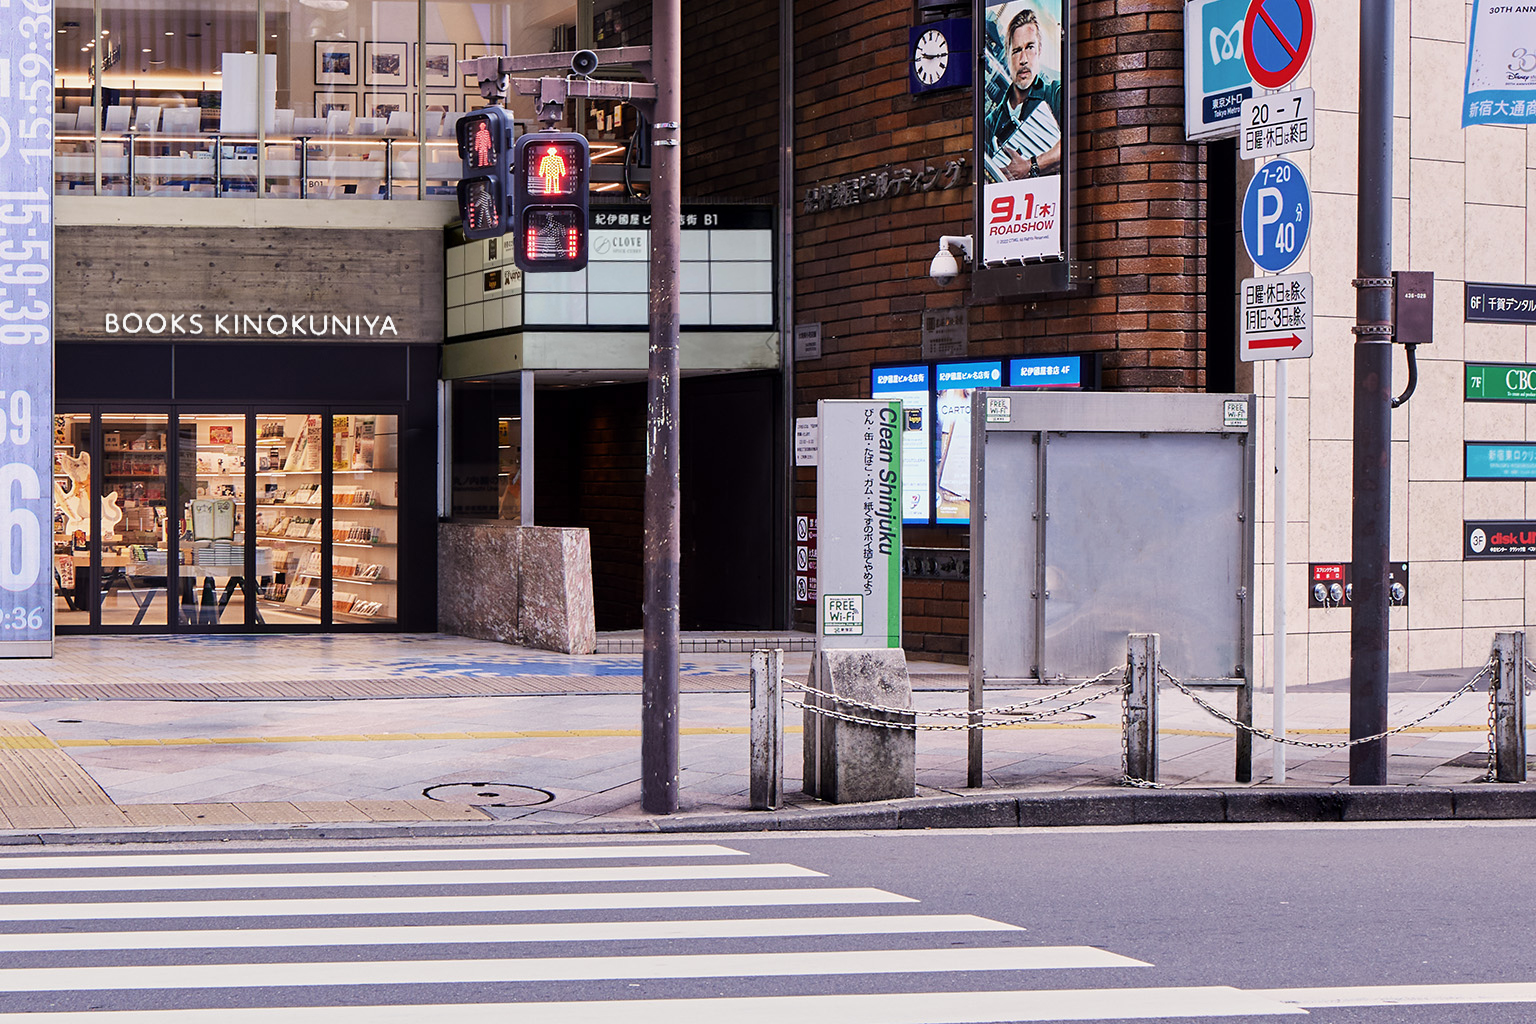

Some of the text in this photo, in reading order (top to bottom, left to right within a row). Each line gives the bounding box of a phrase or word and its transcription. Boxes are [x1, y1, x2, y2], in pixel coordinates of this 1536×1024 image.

[1489, 6, 1513, 15] 30TH
[1211, 93, 1243, 110] 東京メトロ
[1214, 105, 1241, 118] Tokyo Metro
[1251, 103, 1269, 126] 20
[1292, 97, 1302, 118] 7
[1246, 121, 1308, 152] 日曜・休日は終日
[1261, 165, 1291, 186] 7-20
[1295, 202, 1303, 222] 分
[989, 219, 1055, 236] ROADSHOW
[1257, 186, 1284, 257] P
[612, 236, 642, 247] CLOVE
[1275, 221, 1295, 254] 40
[1246, 281, 1307, 306] 日曜・休日を除く
[1470, 296, 1482, 309] 6F
[105, 312, 399, 336] BOOKS KINOKUNIYA
[1061, 365, 1071, 375] 4F
[1470, 376, 1482, 388] 7F
[1488, 449, 1536, 461] 新宿東口クリ
[874, 407, 897, 556] Clean Shinjuku
[1472, 535, 1484, 546] 3F
[1490, 532, 1518, 545] disk
[829, 600, 855, 611] FREE
[829, 611, 855, 622] Wi-Fi
